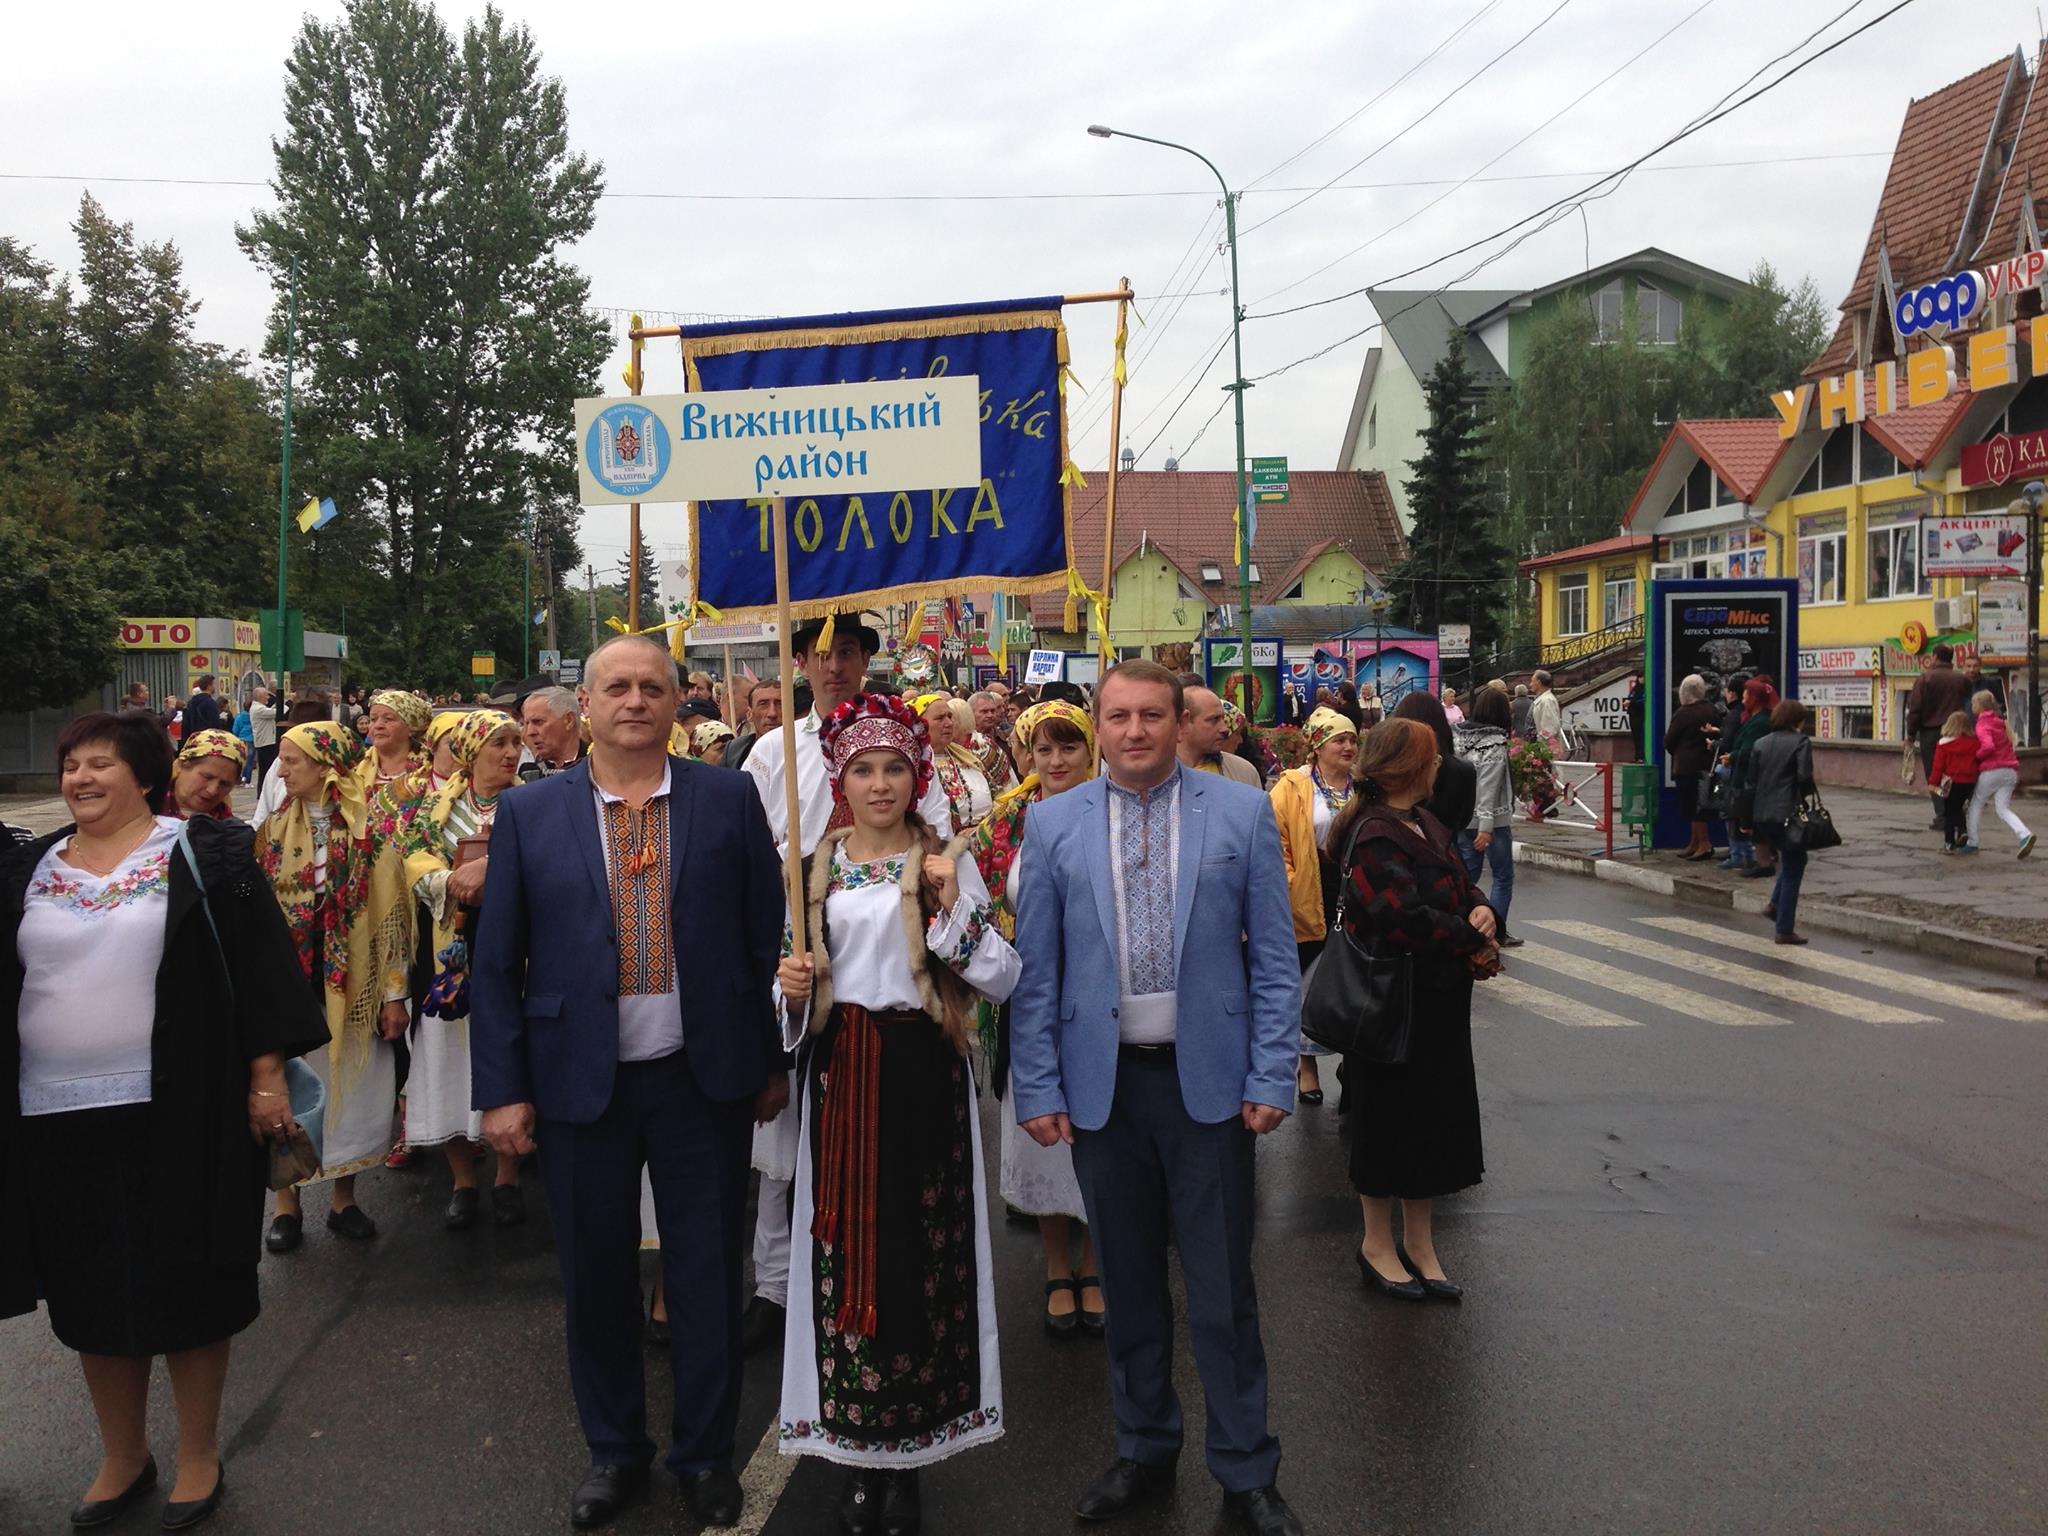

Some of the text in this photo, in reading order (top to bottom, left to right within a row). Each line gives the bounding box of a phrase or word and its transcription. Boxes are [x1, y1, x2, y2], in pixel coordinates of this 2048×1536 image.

[681, 393, 942, 442] Вижницький
[754, 444, 869, 493] район
[121, 623, 192, 645] ОТО
[1006, 624, 1032, 642] тека
